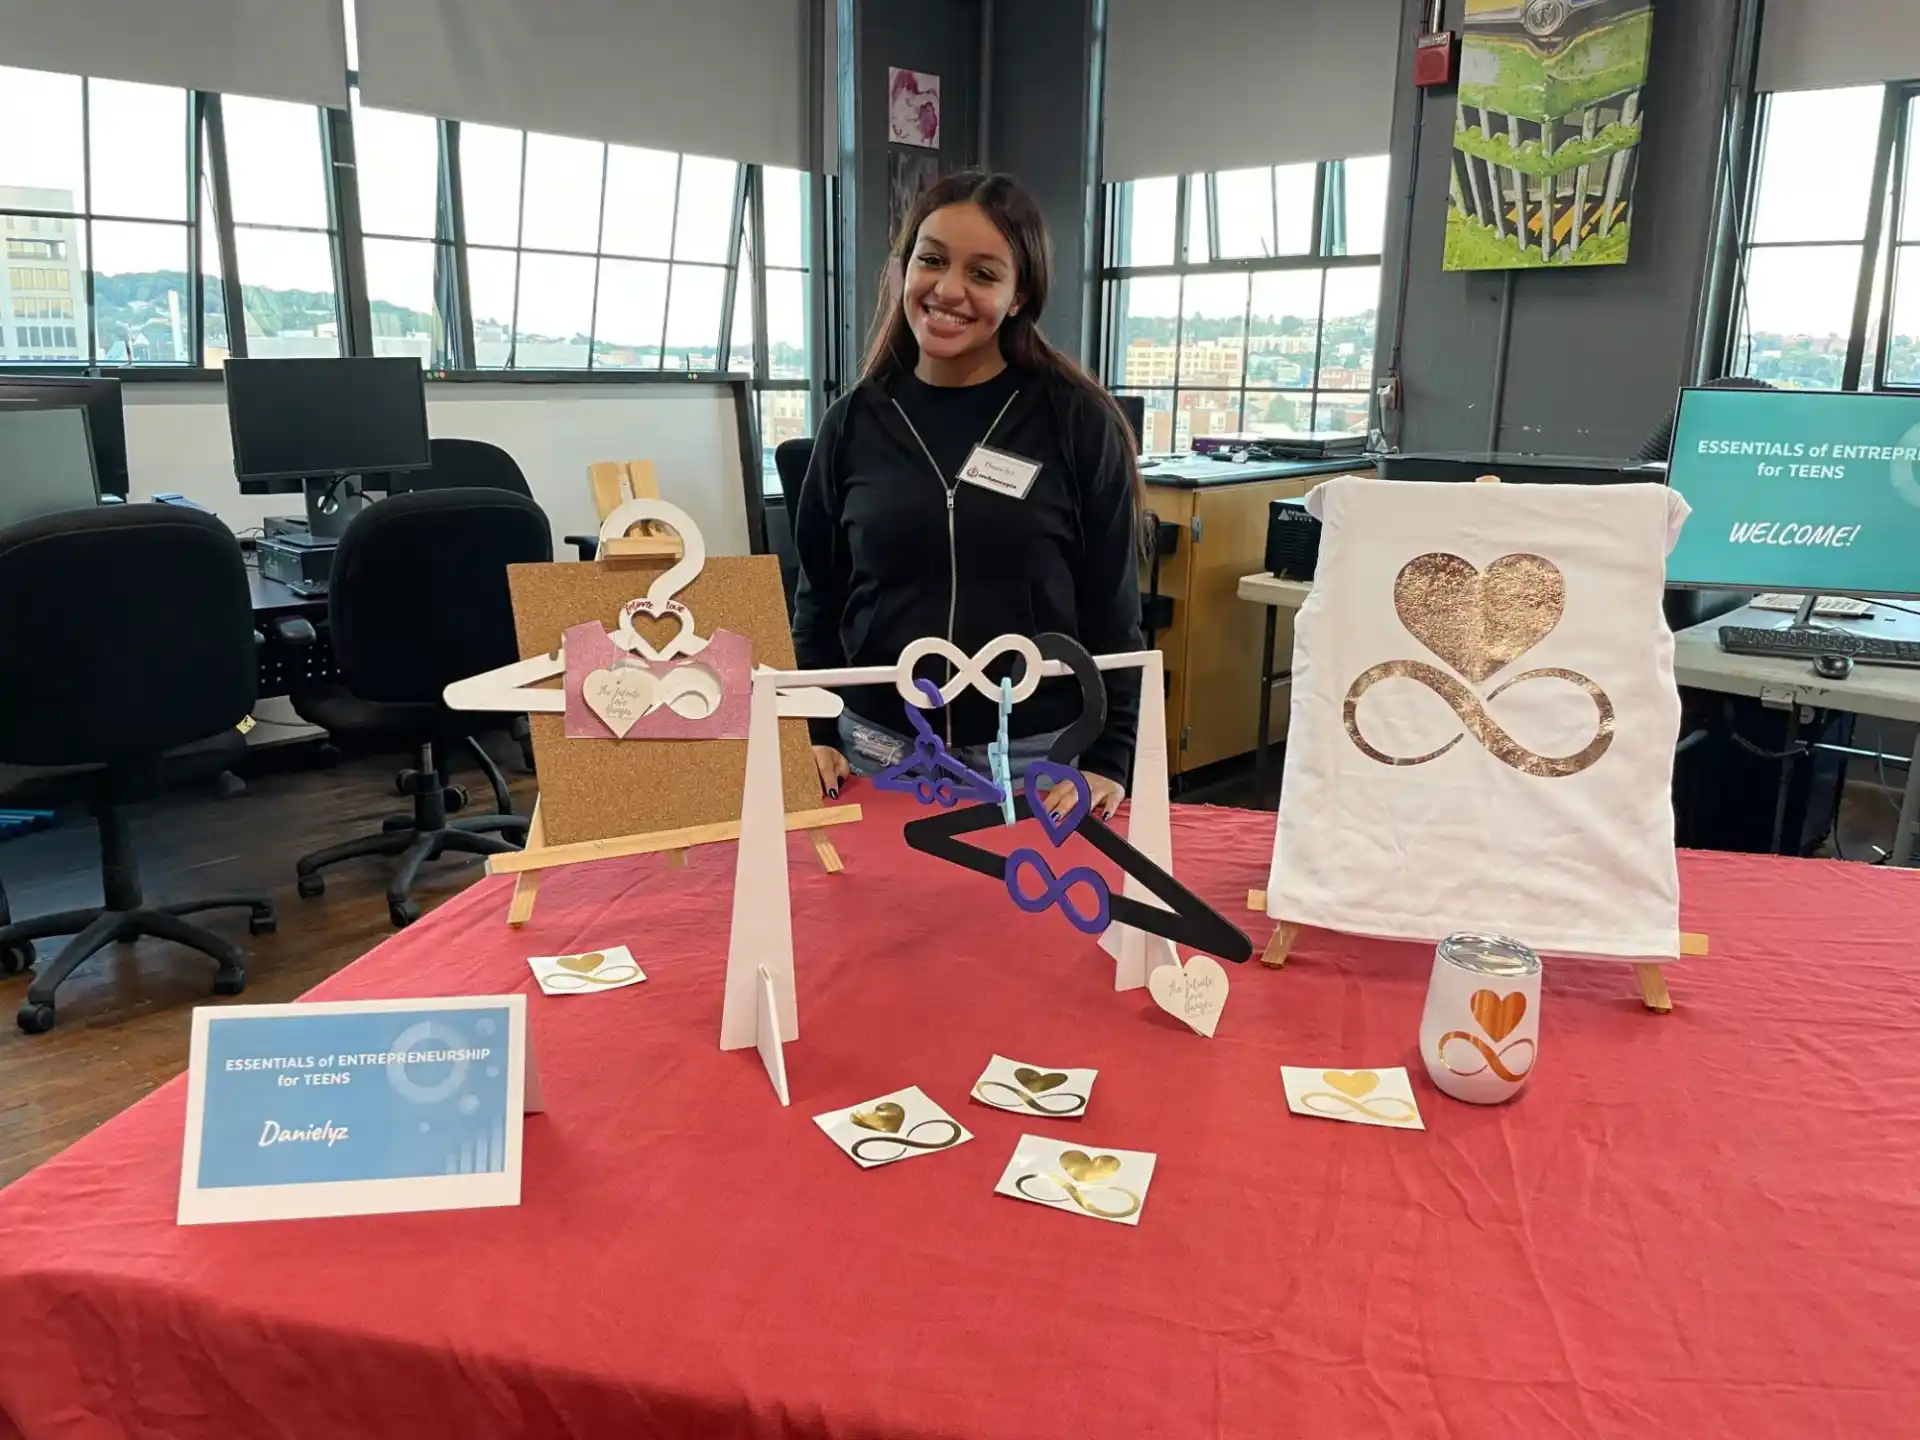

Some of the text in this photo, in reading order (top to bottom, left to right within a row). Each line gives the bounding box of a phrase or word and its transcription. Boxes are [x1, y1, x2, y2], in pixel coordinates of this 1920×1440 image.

[1697, 440, 1920, 461] ESSENTIALS of ENTREPR
[1757, 462, 1845, 479] for TEENS
[1728, 522, 1861, 547] WELCOME!
[226, 1048, 491, 1071] ESSENTIALS of ENTREPRENEURSHIP
[278, 1072, 351, 1087] for TEENS
[258, 1120, 349, 1147] Danielyz
